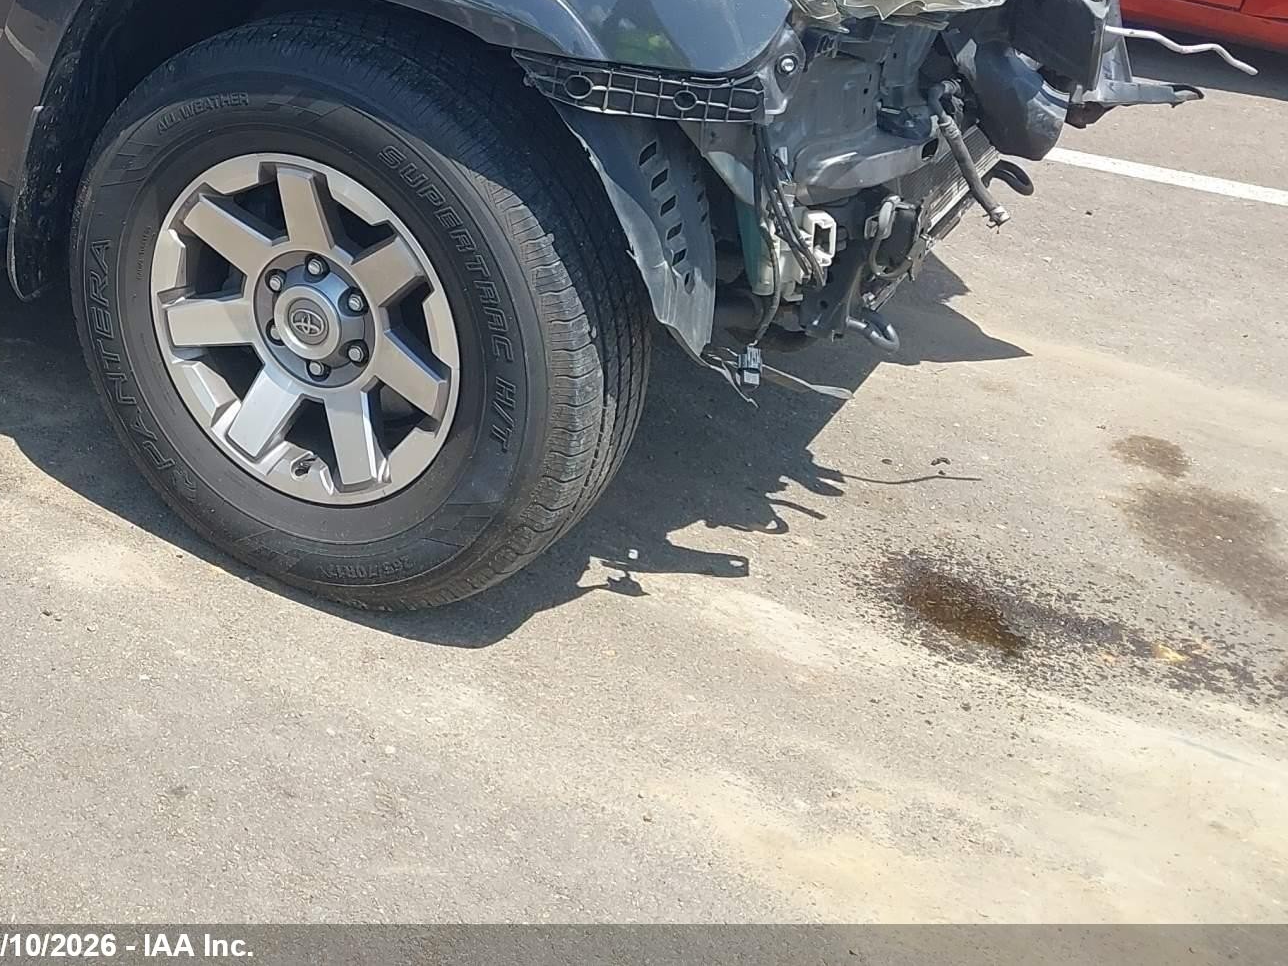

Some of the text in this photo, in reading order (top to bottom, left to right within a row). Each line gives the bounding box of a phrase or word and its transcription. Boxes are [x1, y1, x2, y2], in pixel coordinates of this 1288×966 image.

[157, 92, 250, 135] ALL WEATHER
[89, 238, 176, 471] PANTERA
[378, 145, 517, 453] SUPERTRAC H/T
